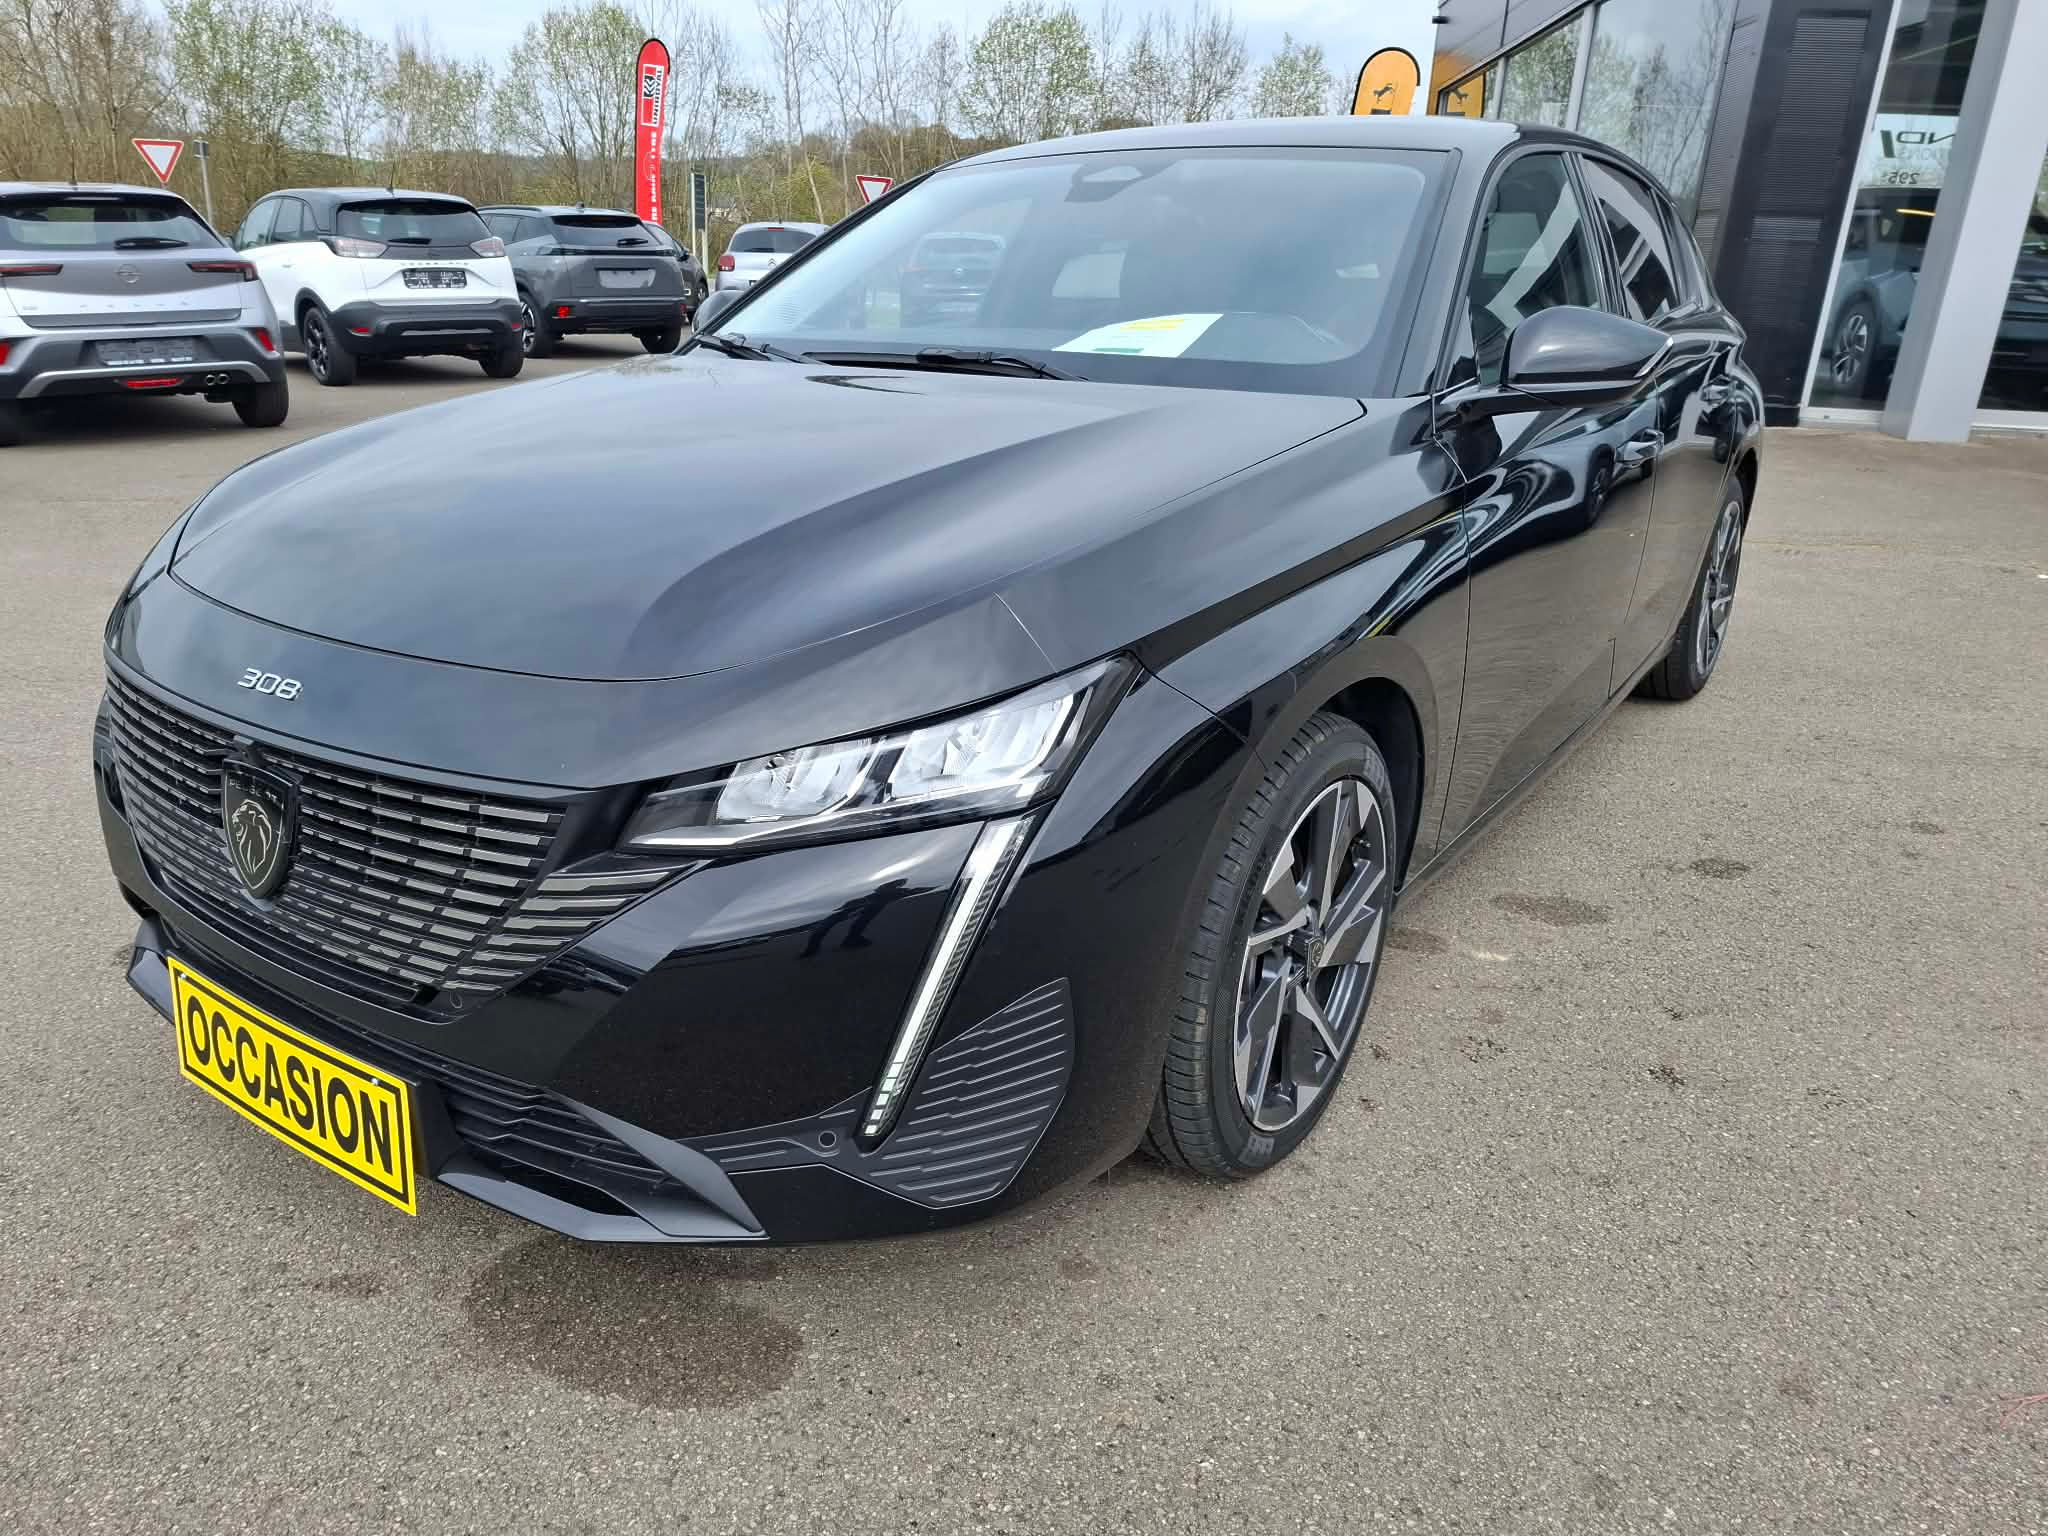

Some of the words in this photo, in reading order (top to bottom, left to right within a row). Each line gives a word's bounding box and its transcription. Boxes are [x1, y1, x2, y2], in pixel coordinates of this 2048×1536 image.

[652, 69, 663, 125] UNIROYAL
[237, 667, 303, 701] 308
[187, 995, 393, 1177] OCCASION
